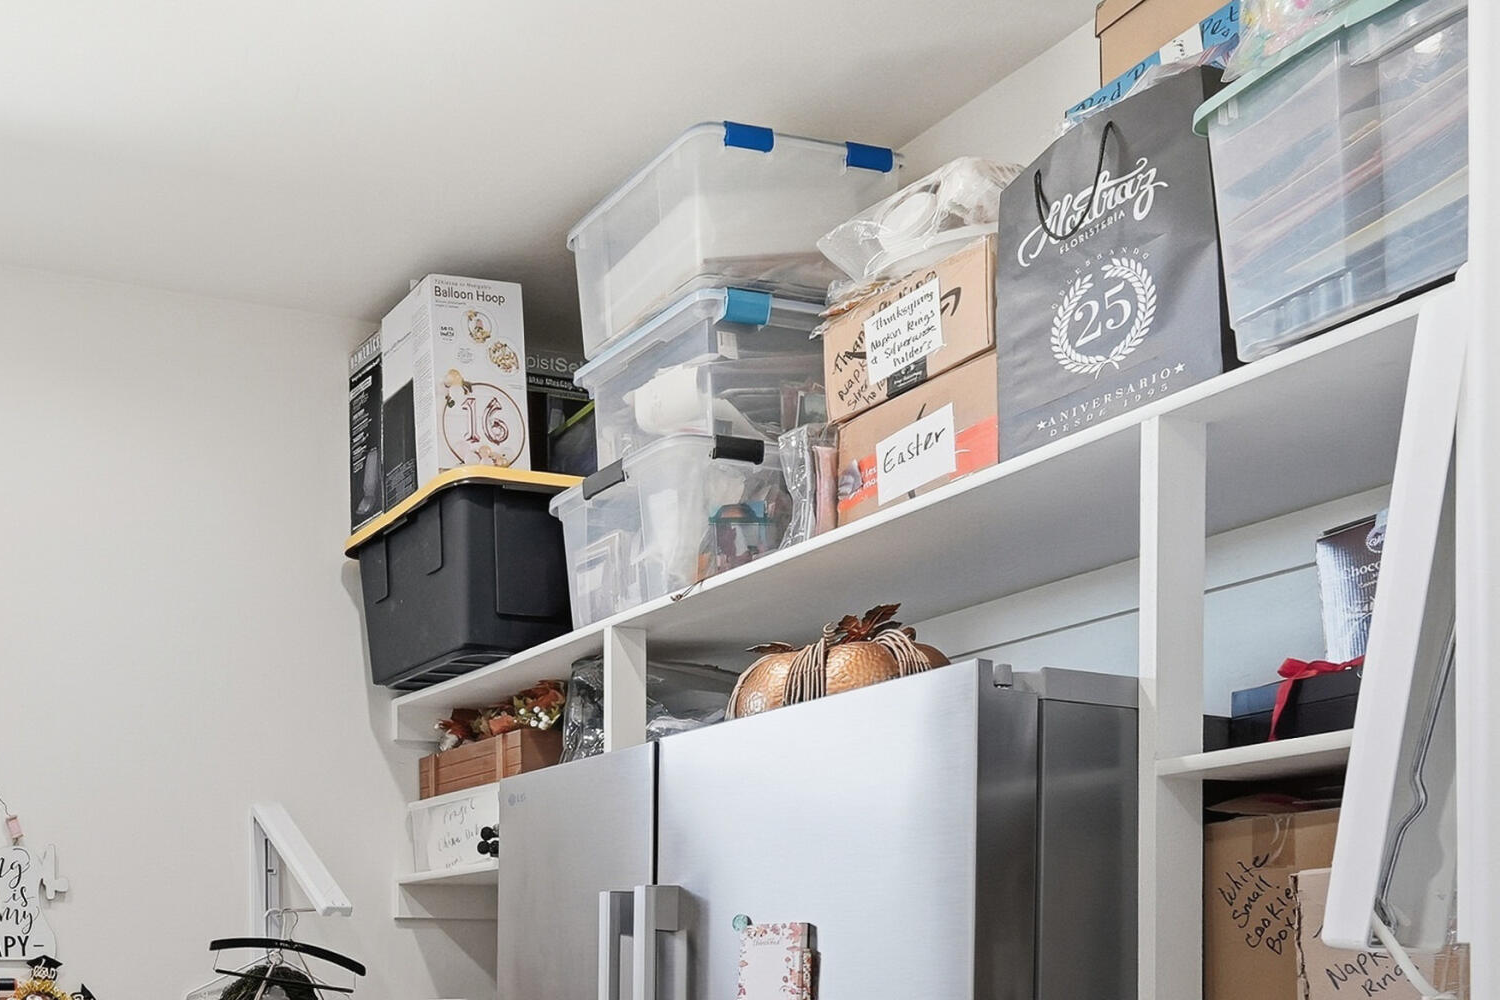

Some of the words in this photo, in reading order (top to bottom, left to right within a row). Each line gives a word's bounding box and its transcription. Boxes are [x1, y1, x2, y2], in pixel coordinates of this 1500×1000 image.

[434, 285, 474, 300] Balloon
[476, 290, 506, 306] Hoop
[1073, 280, 1132, 348] 25
[460, 396, 509, 445] 16
[1047, 367, 1171, 428] ANIVERSARIO
[883, 425, 946, 474] Easter
[4, 885, 30, 908] is
[1218, 853, 1270, 907] White
[0, 907, 41, 934] my
